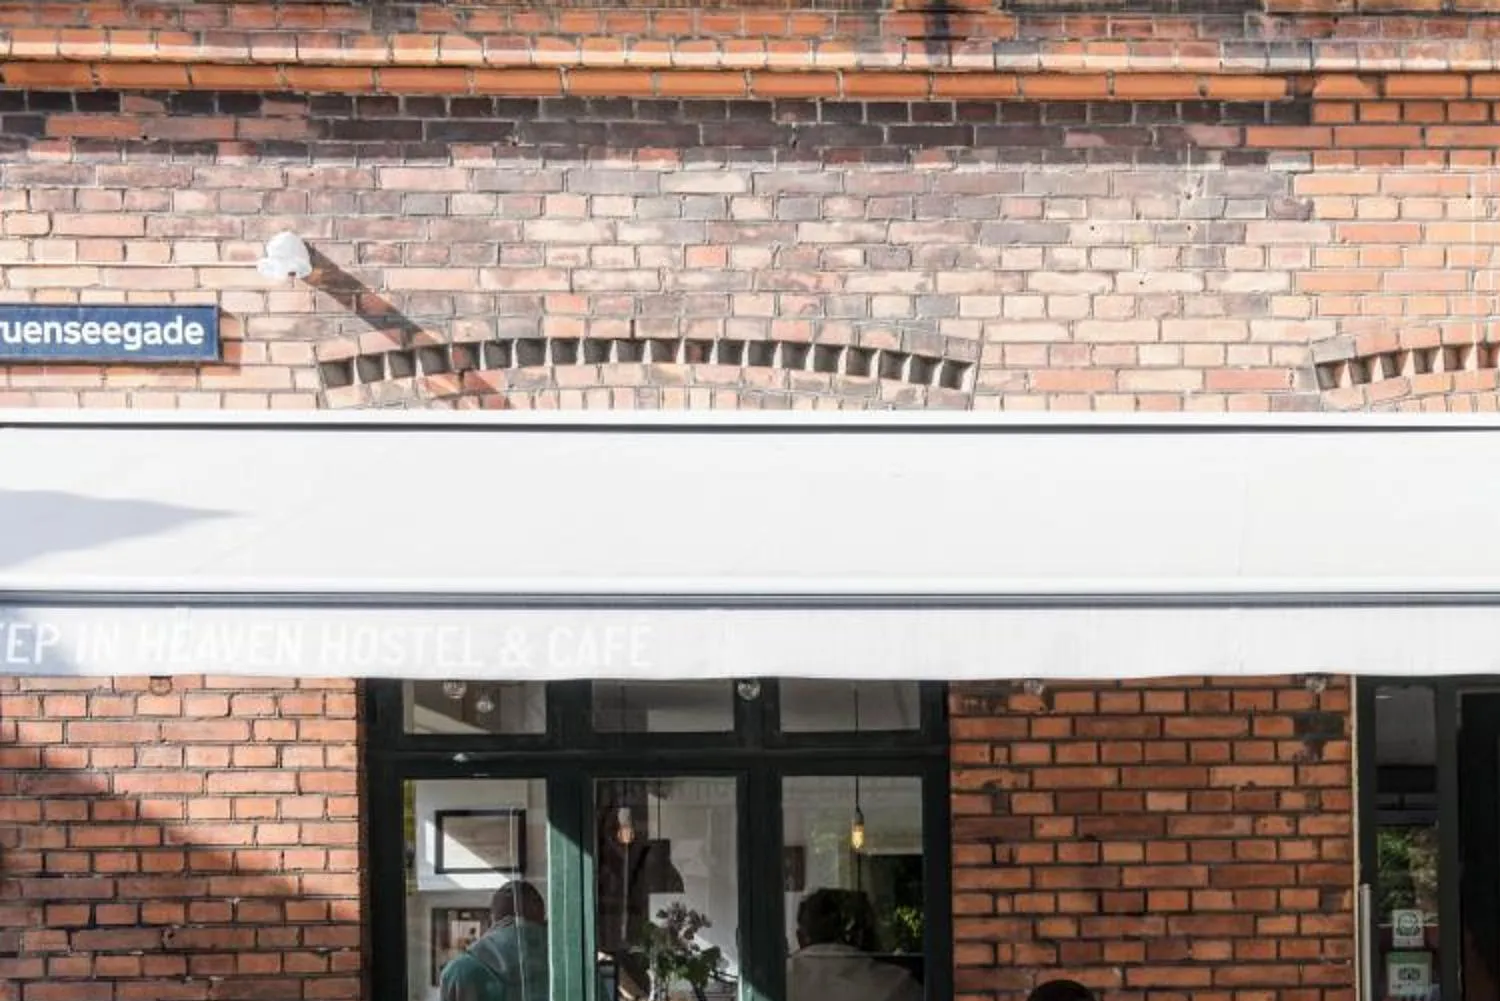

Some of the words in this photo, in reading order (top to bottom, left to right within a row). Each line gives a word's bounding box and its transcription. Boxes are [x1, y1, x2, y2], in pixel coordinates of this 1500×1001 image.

[0, 623, 61, 664] EP
[76, 621, 120, 663] IN
[140, 620, 302, 666] HEAVEN
[320, 621, 486, 668] HOSTEL
[499, 625, 537, 669] &
